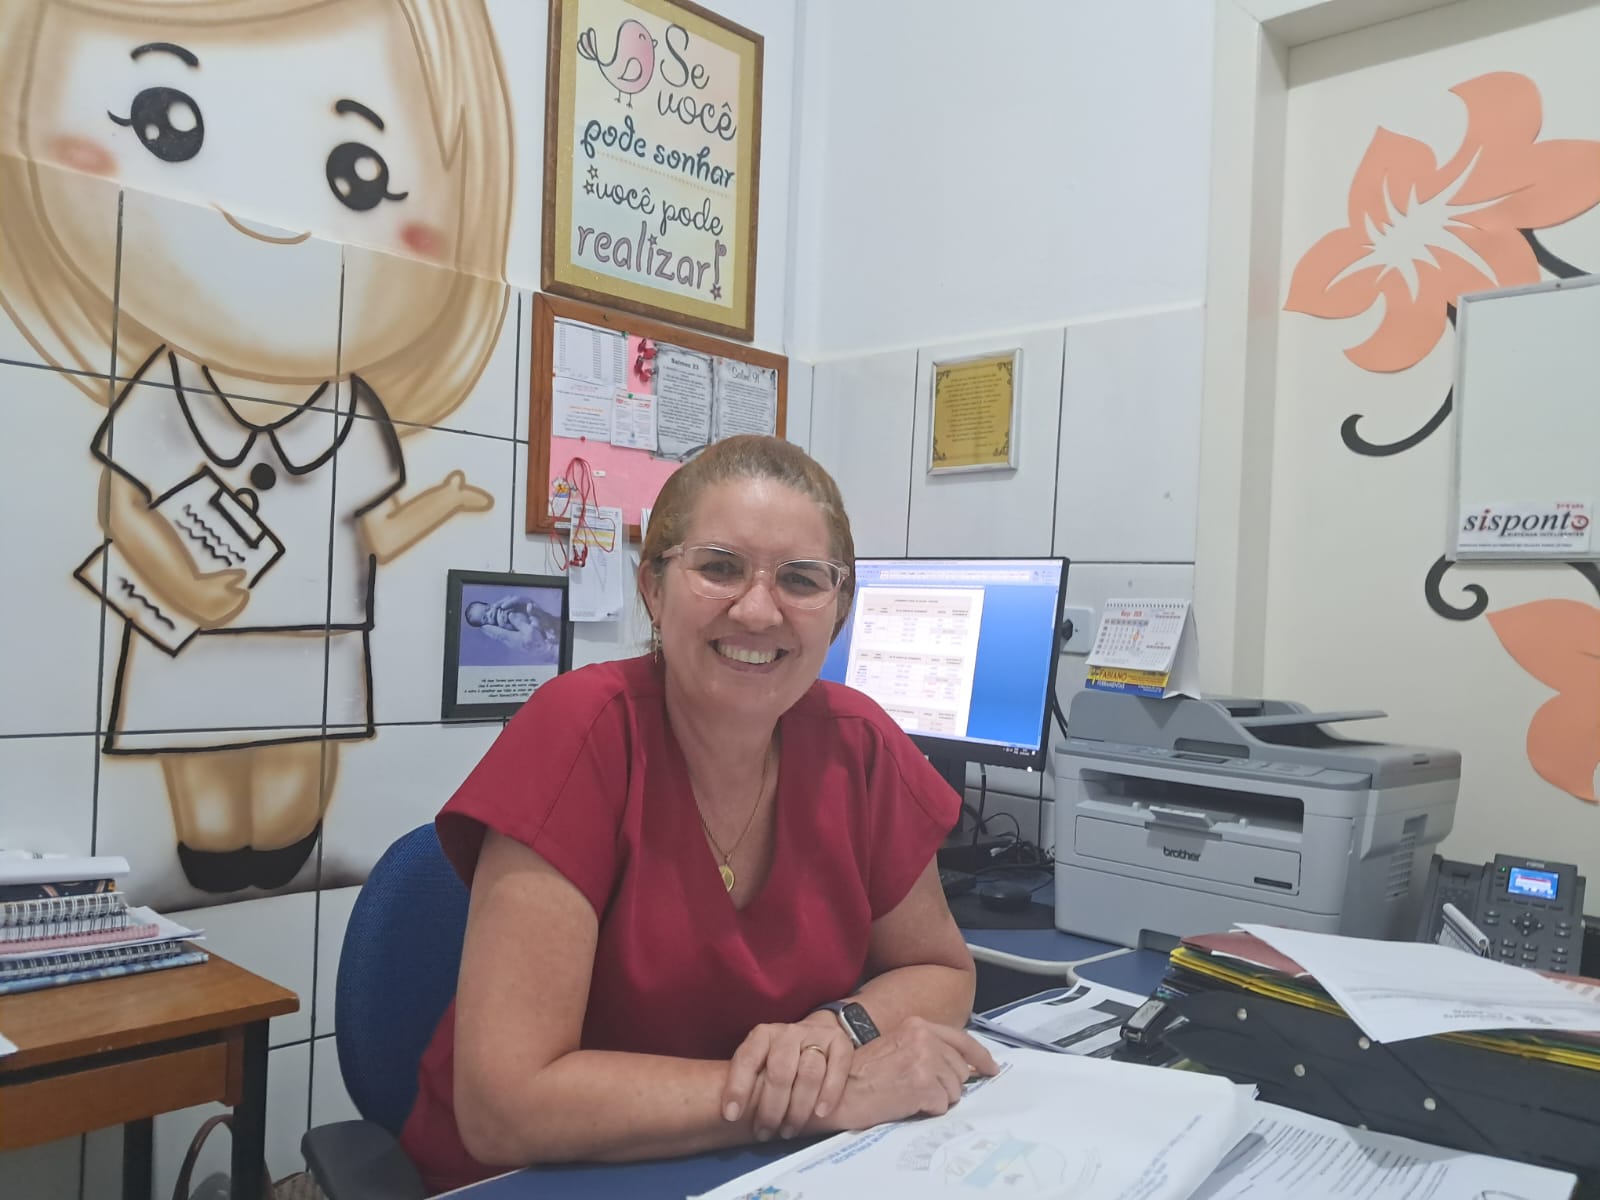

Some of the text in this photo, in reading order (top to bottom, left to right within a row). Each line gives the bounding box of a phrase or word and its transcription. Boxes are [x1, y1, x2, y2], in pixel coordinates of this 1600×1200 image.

[660, 24, 709, 89] Se
[657, 90, 736, 140] você
[580, 115, 735, 188] pode sonhar
[596, 181, 723, 236] você pode
[577, 220, 727, 300] realizar!
[1163, 845, 1201, 862] brother
